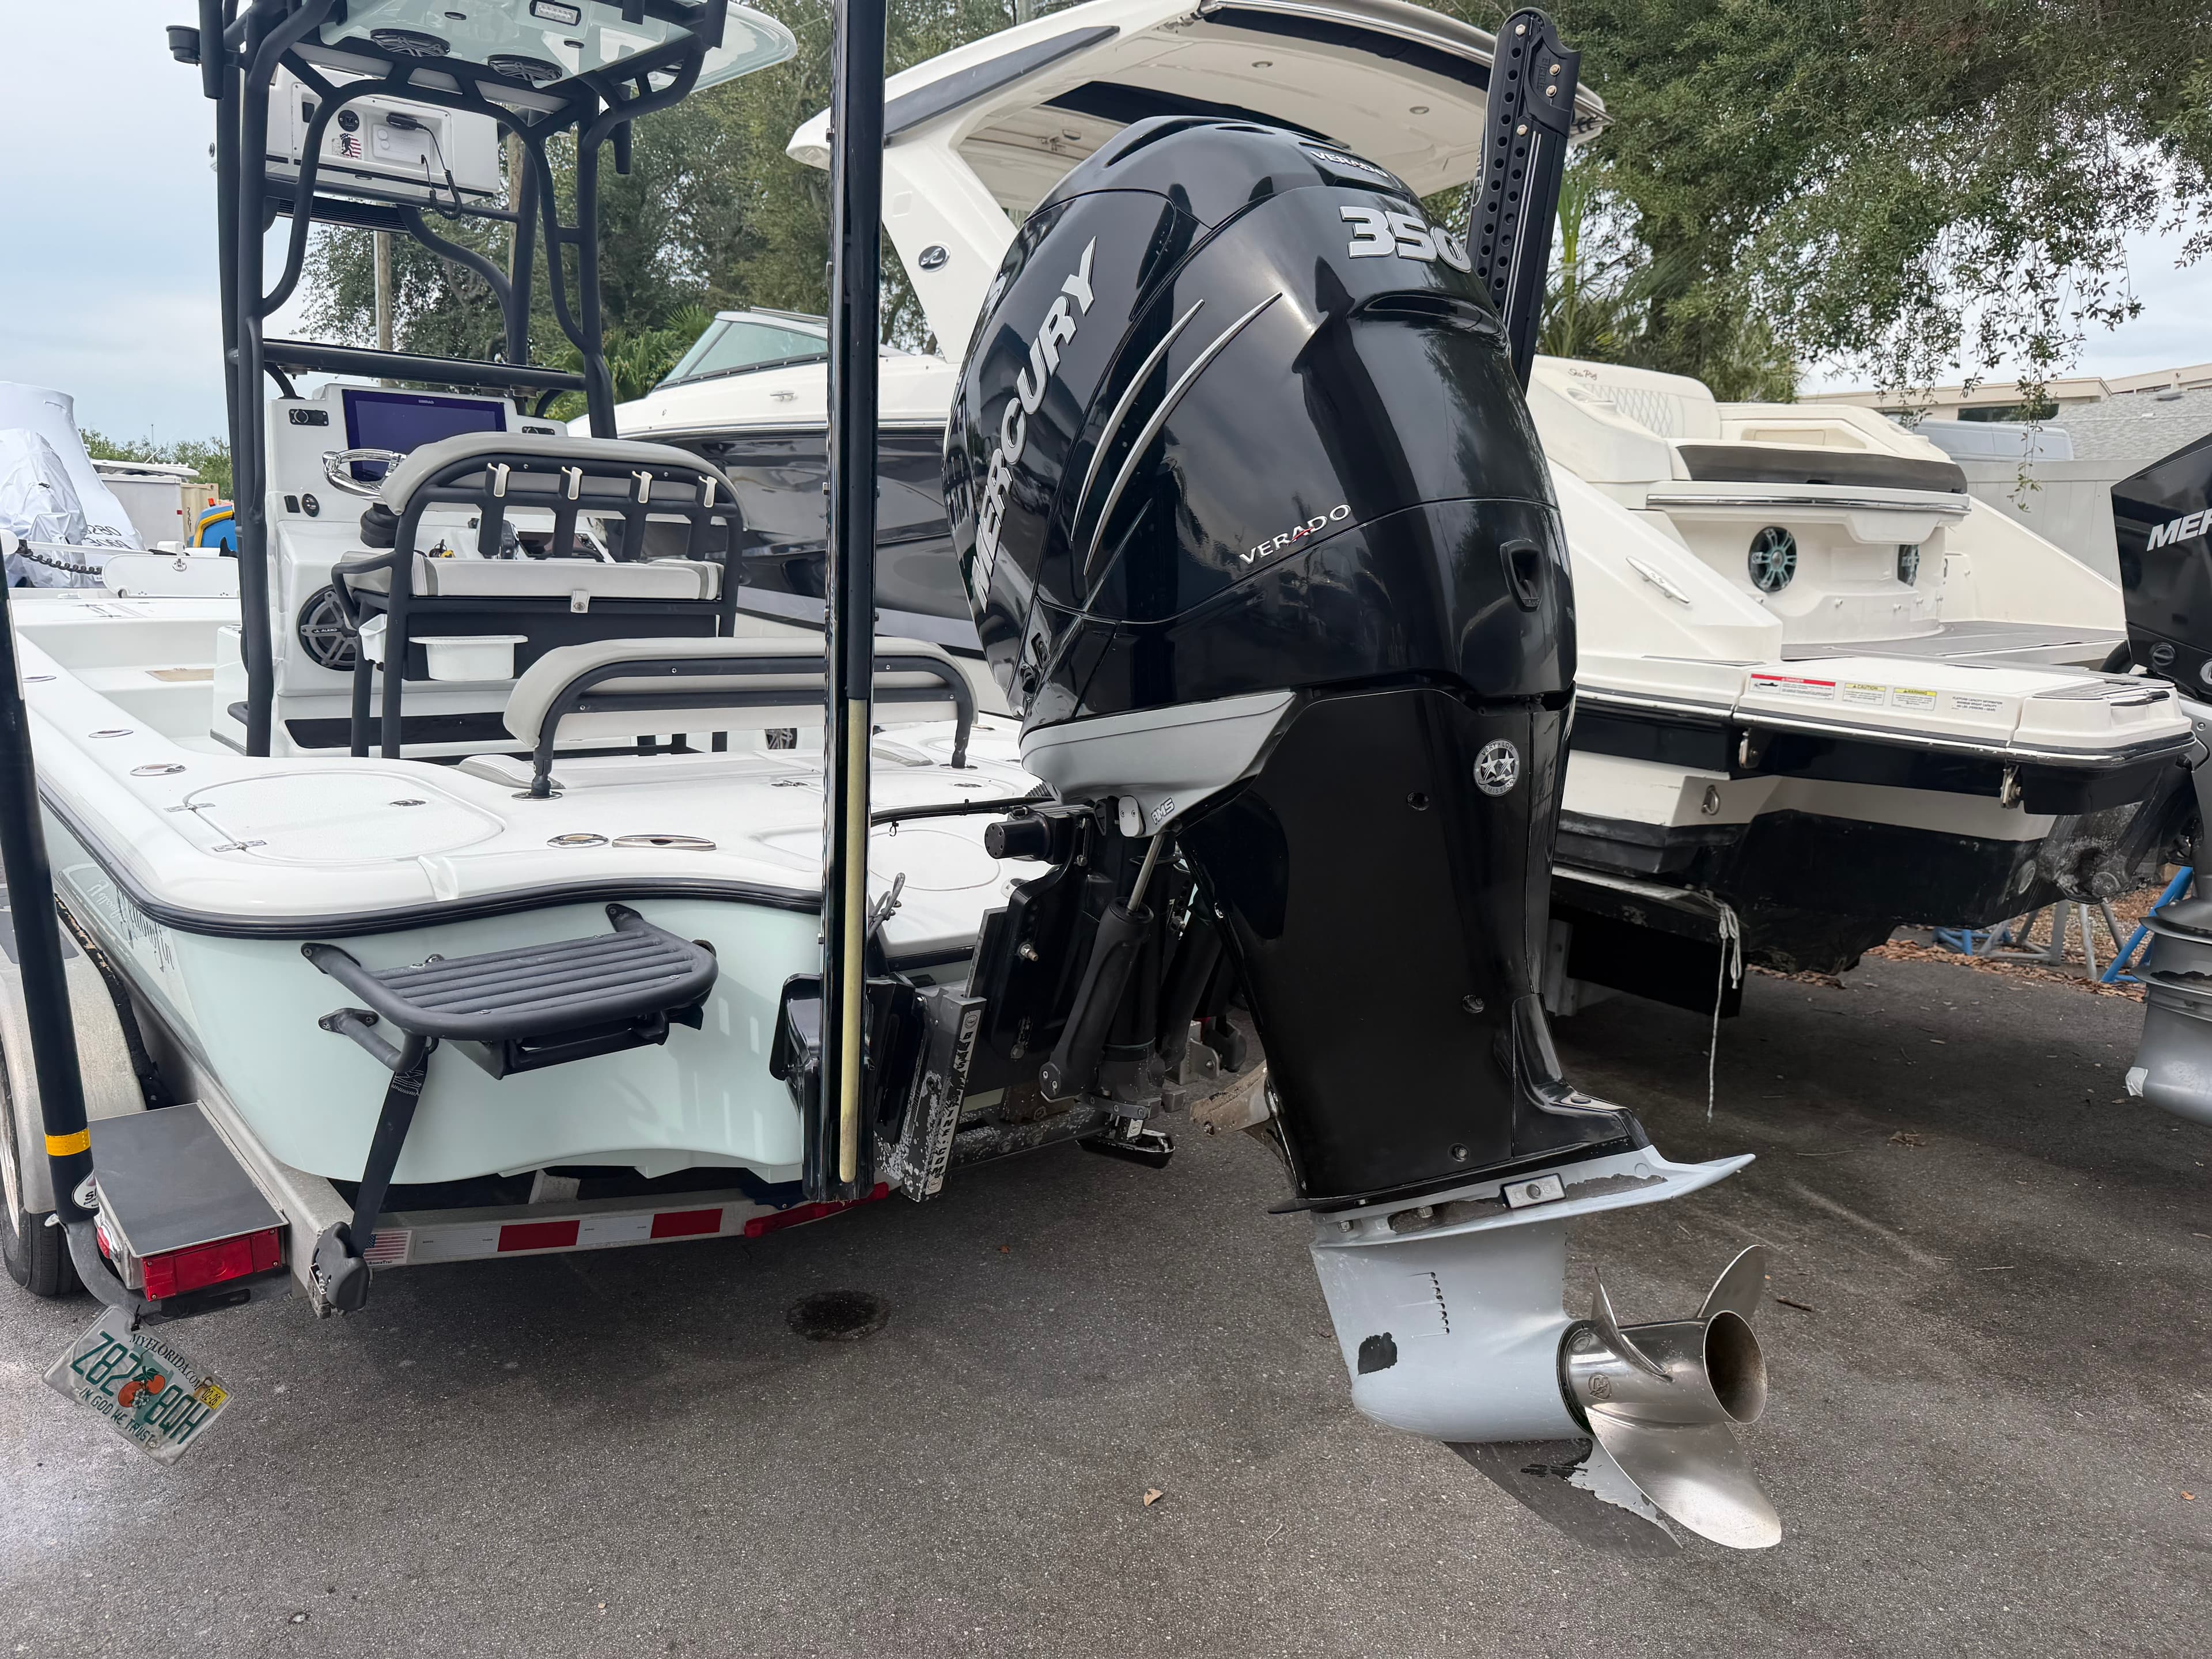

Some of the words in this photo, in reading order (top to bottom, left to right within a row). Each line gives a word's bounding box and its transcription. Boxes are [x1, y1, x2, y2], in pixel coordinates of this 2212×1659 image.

[1310, 150, 1388, 178] VERADO
[1339, 206, 1471, 273] 350
[973, 235, 1097, 613] MERCURY
[1239, 504, 1351, 565] VERADO
[1481, 742, 1497, 756] VERY
[1502, 741, 1514, 751] LOW
[70, 1331, 142, 1397] Z82
[129, 1334, 202, 1391] MYFLORIDA.COM
[80, 1387, 93, 1402] IN
[90, 1396, 114, 1415] GOD
[110, 1411, 126, 1426] WE
[126, 1418, 156, 1444] TRUST
